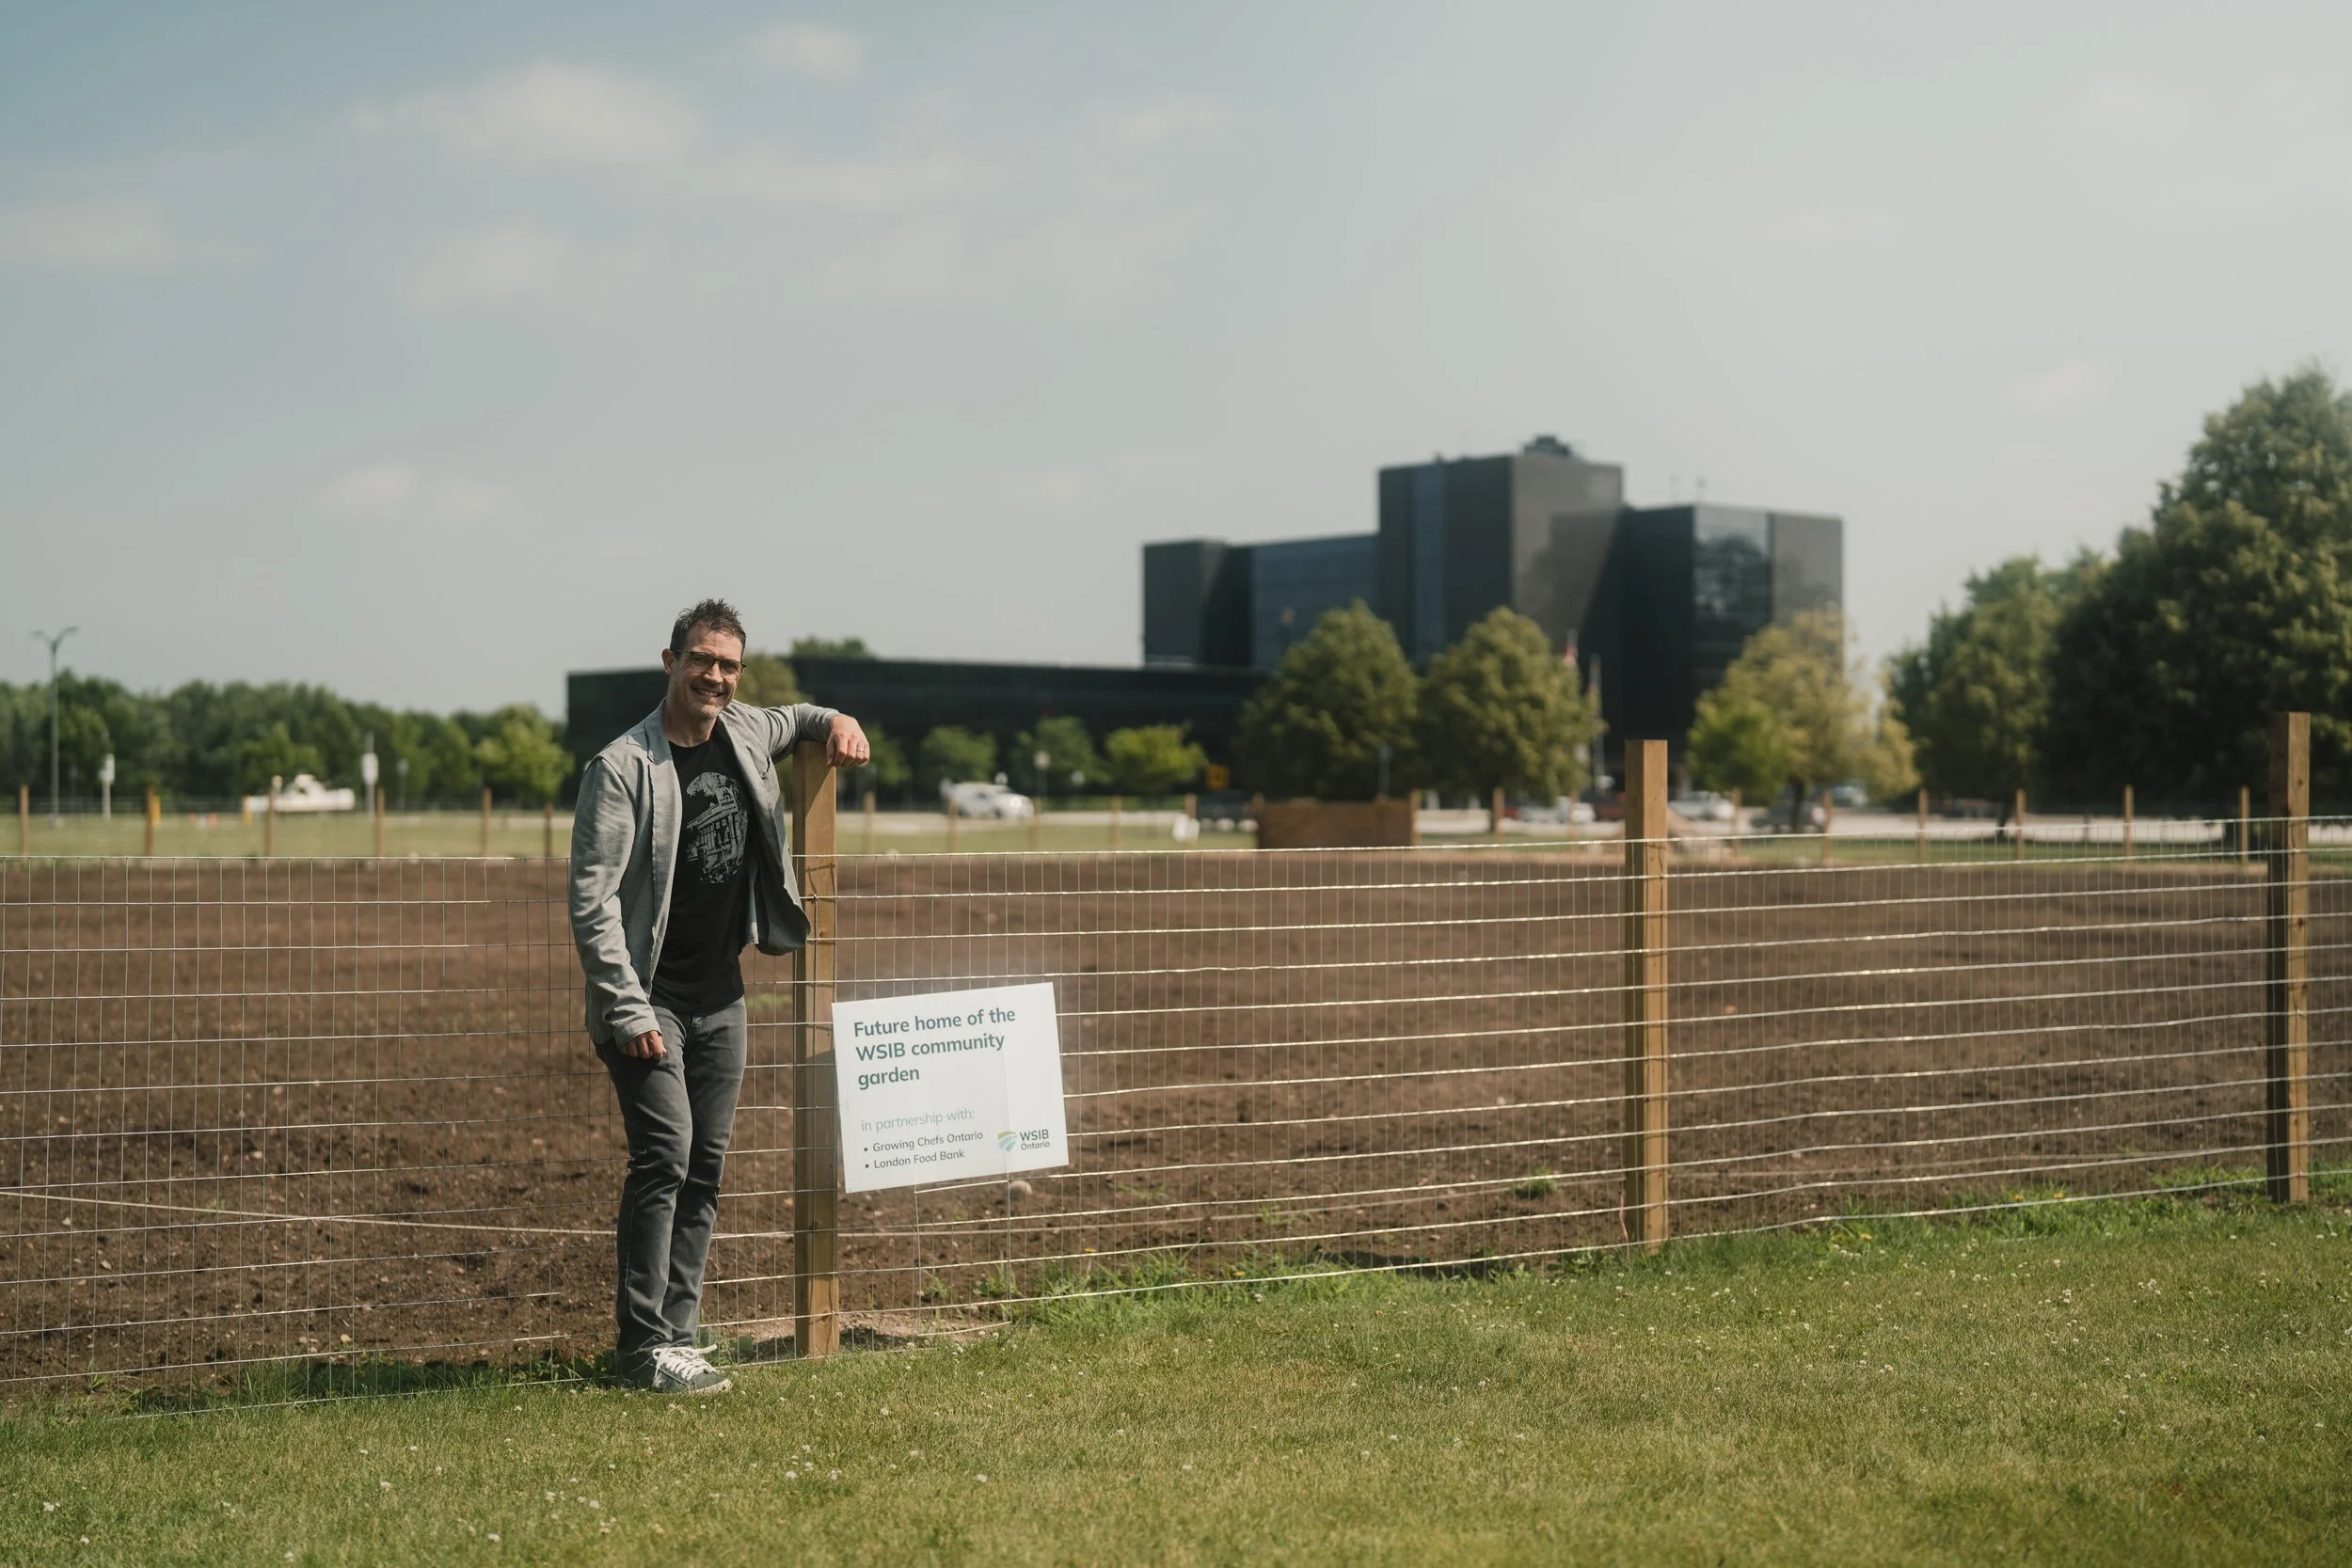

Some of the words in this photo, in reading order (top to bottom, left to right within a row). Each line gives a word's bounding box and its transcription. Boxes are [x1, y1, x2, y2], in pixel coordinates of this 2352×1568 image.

[854, 1021, 909, 1037] Future
[915, 1015, 961, 1031] home
[967, 1009, 984, 1025] of
[989, 1007, 1016, 1023] the
[856, 1042, 905, 1061] WSIB
[911, 1033, 1005, 1055] community
[858, 1067, 920, 1090] garden
[861, 1119, 872, 1132] in
[876, 1112, 943, 1133] partnership
[946, 1108, 976, 1122] with:
[872, 1139, 914, 1152] Growing
[917, 1134, 945, 1147] Chefs
[946, 1131, 984, 1143] Ontario
[1020, 1129, 1049, 1142] WSIB
[1021, 1140, 1050, 1150] Ontario
[874, 1156, 911, 1169] London
[914, 1152, 937, 1164] Food
[940, 1148, 965, 1161] Bank
